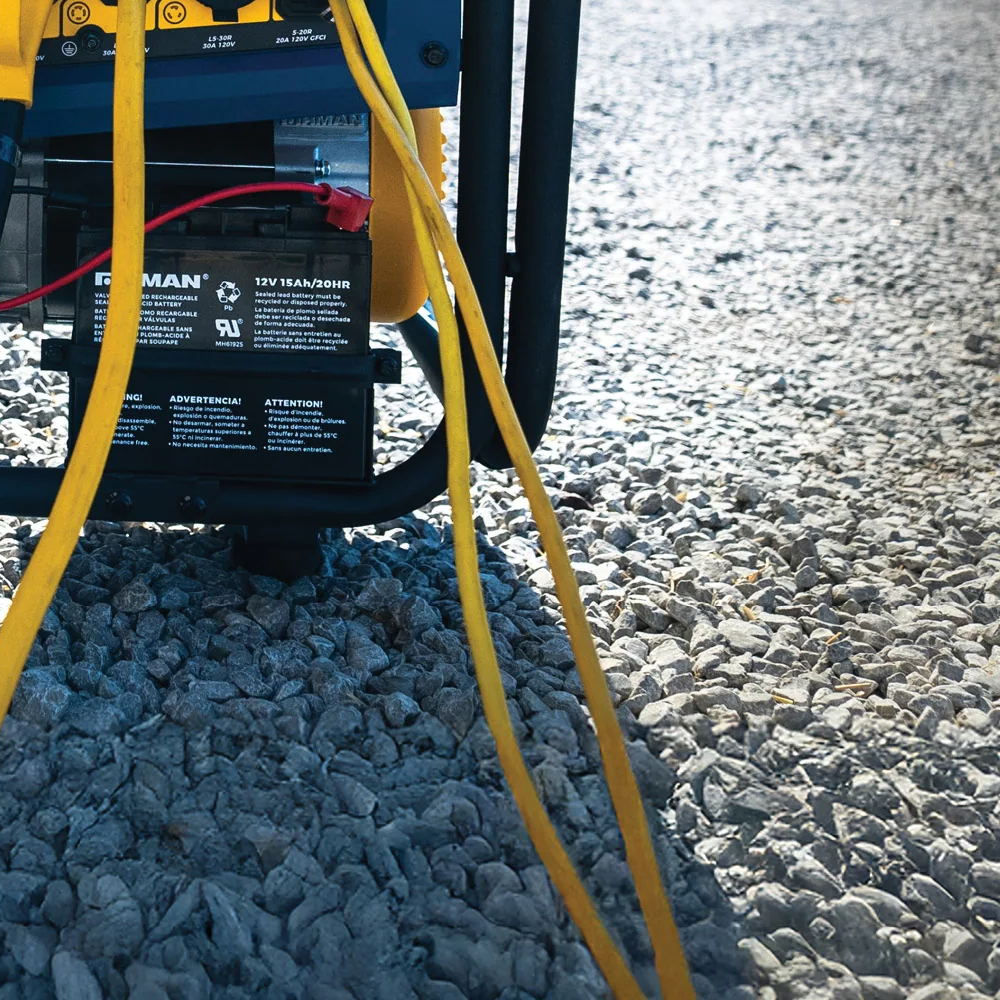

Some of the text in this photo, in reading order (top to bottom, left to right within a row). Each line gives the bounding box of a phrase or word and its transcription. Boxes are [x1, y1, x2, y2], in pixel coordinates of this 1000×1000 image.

[95, 272, 201, 289] FMAN
[255, 278, 350, 288] 12V 15Ah/20HR
[322, 336, 348, 345] recyclée
[170, 396, 241, 404] ADVERTENCIA!
[264, 399, 323, 407] ATTENTION!
